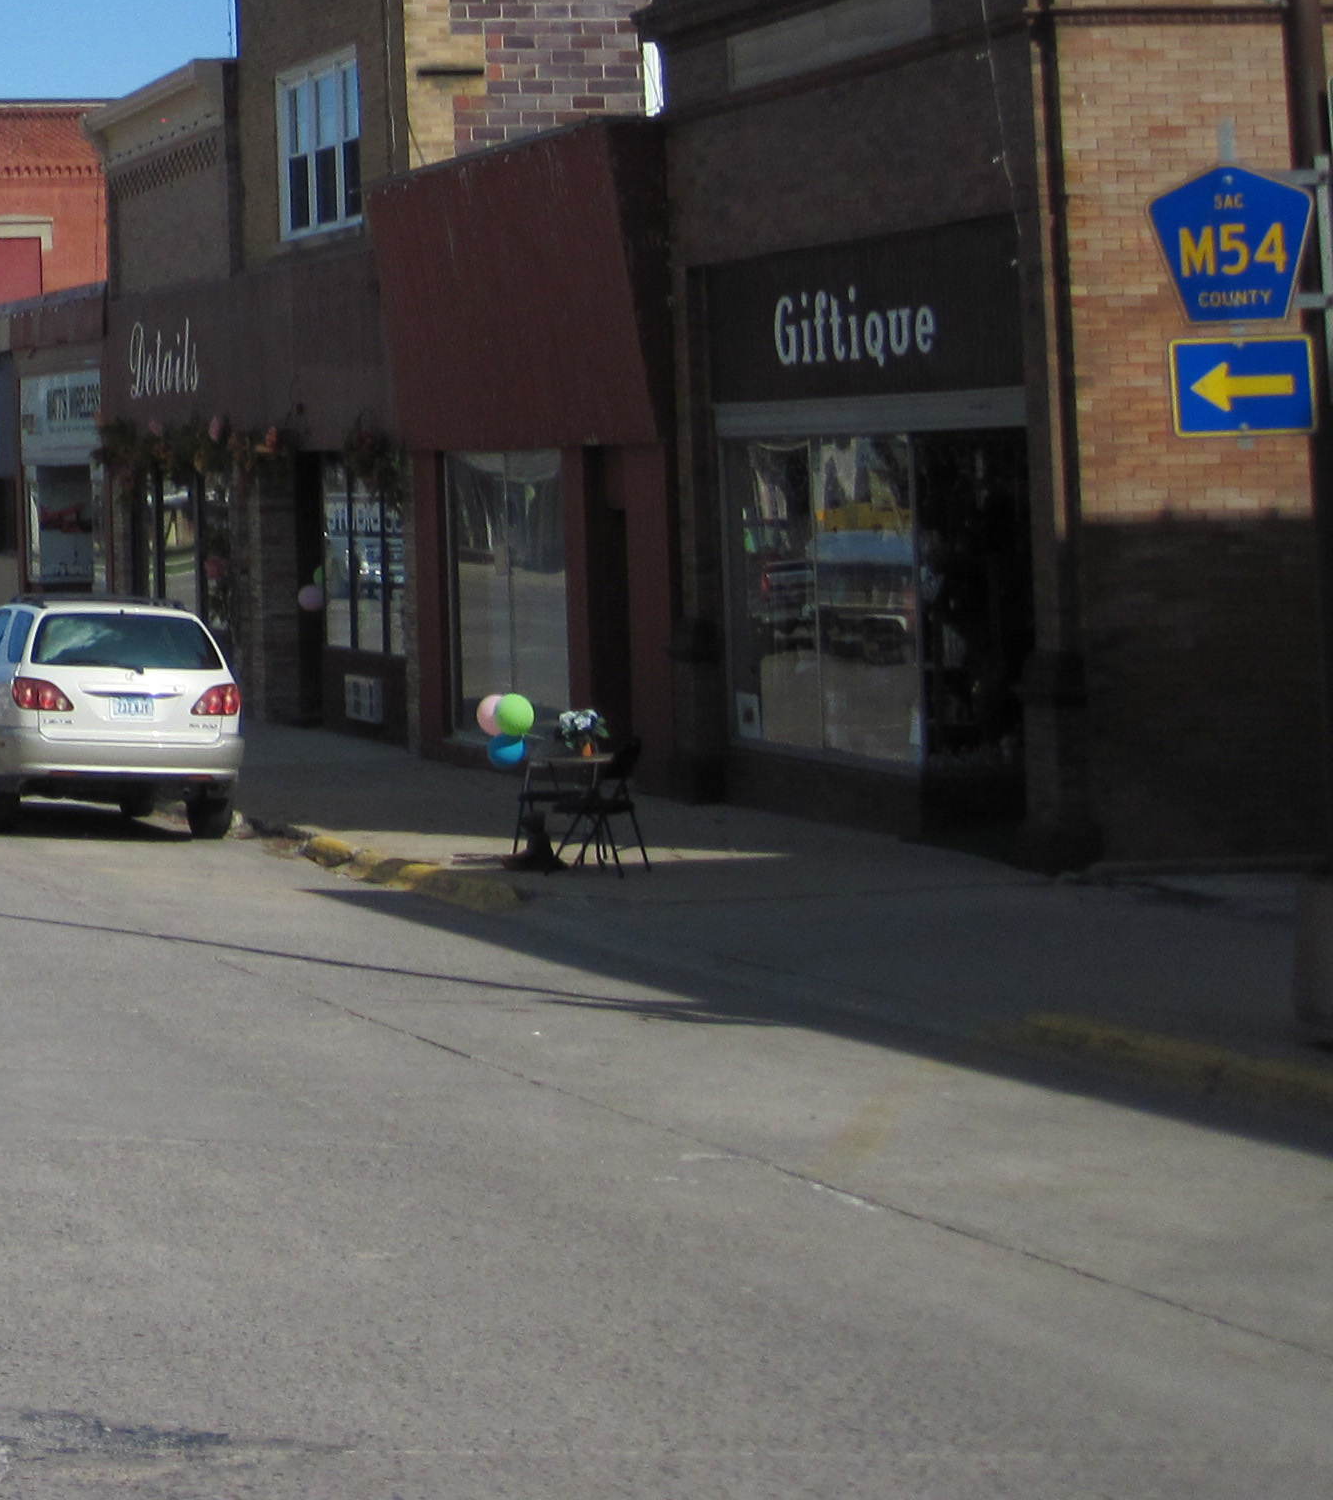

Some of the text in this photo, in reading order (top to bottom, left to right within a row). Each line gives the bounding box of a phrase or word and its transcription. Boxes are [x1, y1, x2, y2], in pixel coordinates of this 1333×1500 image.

[1214, 192, 1244, 210] SAC
[1178, 222, 1288, 277] M54
[1198, 288, 1271, 308] COUNTY
[774, 285, 935, 368] Giftique
[130, 317, 200, 399] Details
